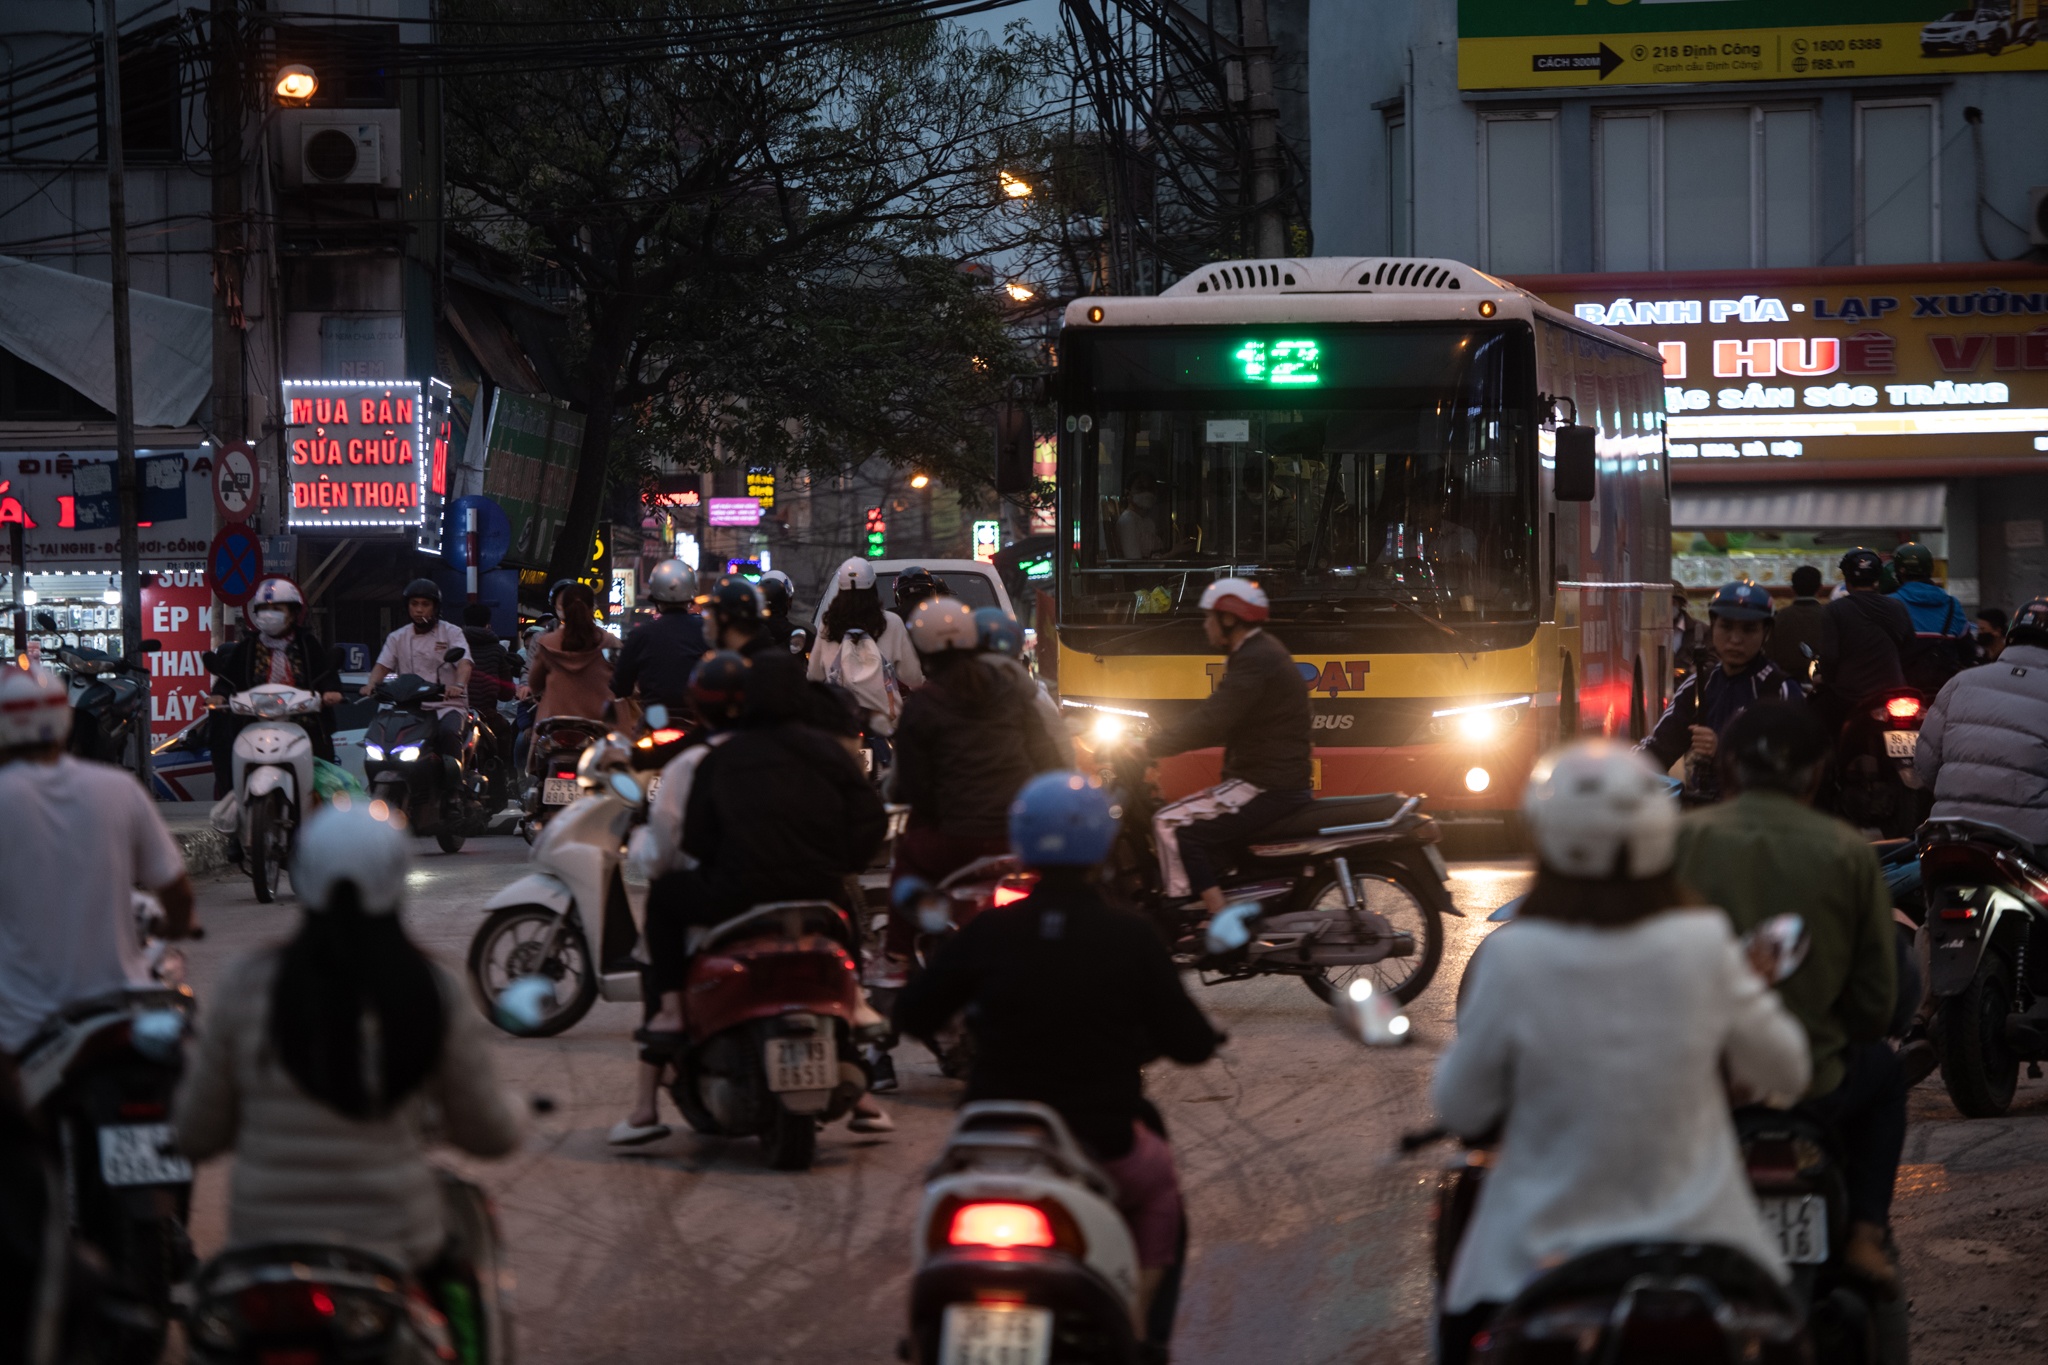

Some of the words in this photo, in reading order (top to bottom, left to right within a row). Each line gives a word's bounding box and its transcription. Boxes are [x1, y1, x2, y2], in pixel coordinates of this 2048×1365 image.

[1653, 46, 1678, 58] 218
[1683, 44, 1716, 59] Định
[1721, 43, 1761, 59] Công
[1812, 41, 1845, 52] 1800
[1849, 38, 1882, 51] 6388
[1537, 55, 1570, 69] CÁCH
[1572, 56, 1601, 68] 300M
[1575, 298, 1701, 325] BÁNH
[1709, 296, 1789, 323] PÍA
[1813, 297, 1898, 325] LẠP
[1911, 286, 2048, 318] XƯỞN
[341, 360, 384, 378] NEM
[1713, 329, 1898, 377] HUÊ
[291, 398, 349, 424] MUA
[361, 390, 413, 424] BÁN
[1664, 386, 1710, 413] ẶC
[1804, 382, 1878, 407] SÓC
[1885, 380, 2009, 406] TRĂNG
[293, 427, 343, 465] SỬA
[349, 430, 413, 464] CHỮA
[293, 473, 348, 515] ĐIỆN
[352, 482, 418, 514] THOẠI
[39, 543, 58, 555] TAI
[61, 542, 95, 555] NGHE
[167, 538, 206, 552] CÔNG
[153, 601, 189, 632] ÉP
[147, 651, 205, 677] THAY
[151, 686, 198, 721] LẤY
